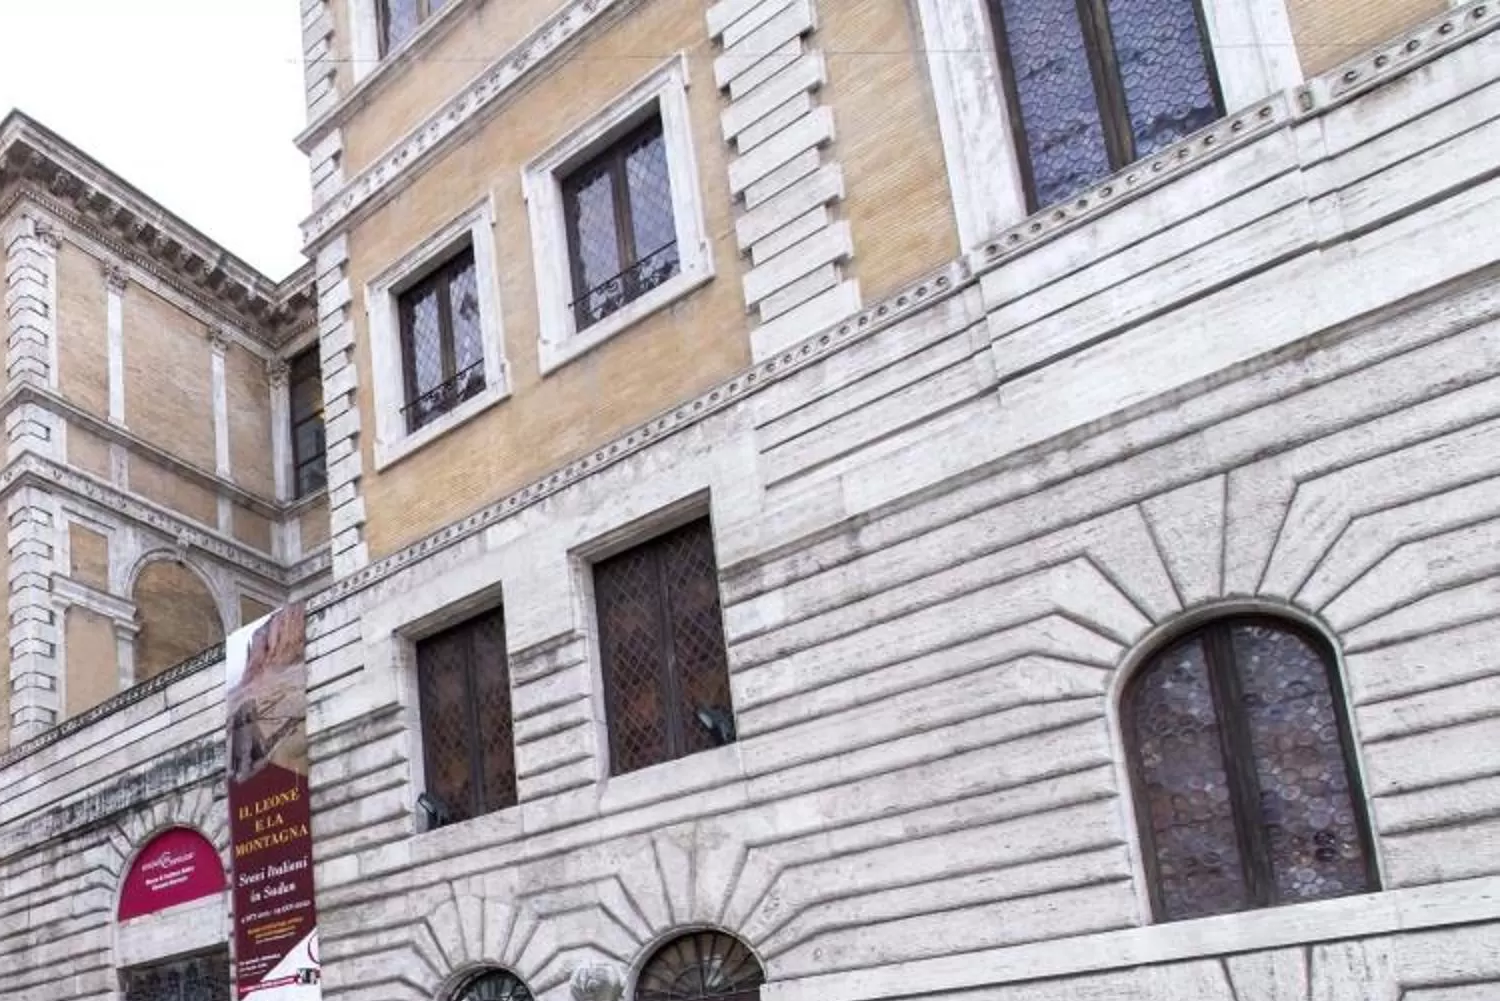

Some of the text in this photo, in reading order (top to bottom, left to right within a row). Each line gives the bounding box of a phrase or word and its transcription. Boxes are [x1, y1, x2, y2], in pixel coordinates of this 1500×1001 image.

[255, 787, 299, 813] LEONE
[267, 813, 284, 828] LA
[235, 824, 308, 857] MONTAGNA
